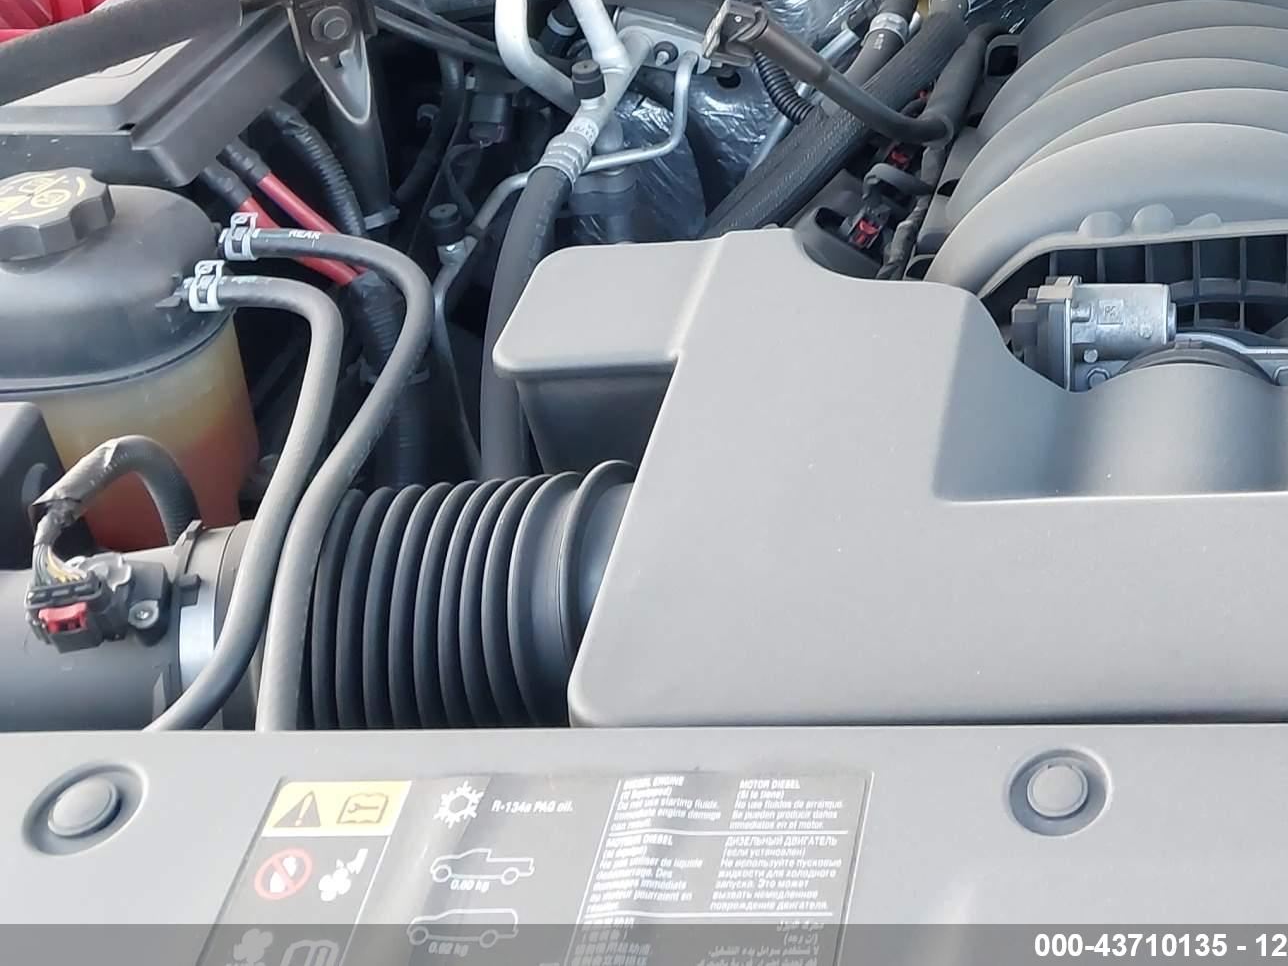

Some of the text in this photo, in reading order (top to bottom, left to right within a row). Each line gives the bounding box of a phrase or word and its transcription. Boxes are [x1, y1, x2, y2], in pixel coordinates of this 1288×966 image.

[739, 779, 801, 790] MOTOR DIESEL
[533, 800, 556, 813] PAG
[744, 811, 775, 821] pueden
[776, 810, 811, 821] producir
[784, 836, 838, 846] ДВИГАТЕЛЬ
[475, 879, 490, 893] kg
